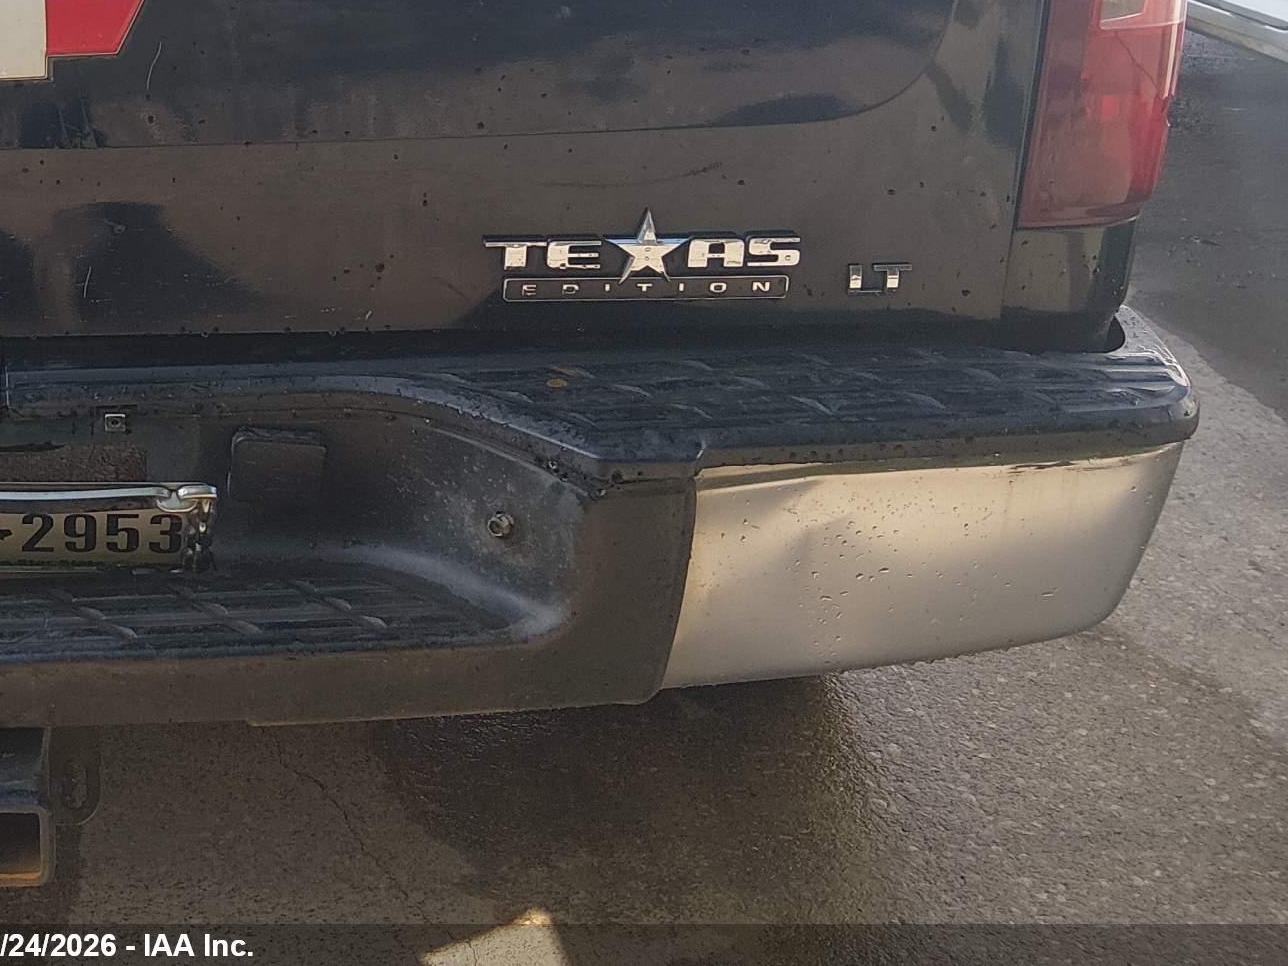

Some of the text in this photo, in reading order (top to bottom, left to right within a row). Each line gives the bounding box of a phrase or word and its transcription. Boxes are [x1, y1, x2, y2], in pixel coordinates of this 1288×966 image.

[521, 281, 771, 298] EDITION
[847, 263, 912, 295] LT
[21, 512, 184, 554] 2953
